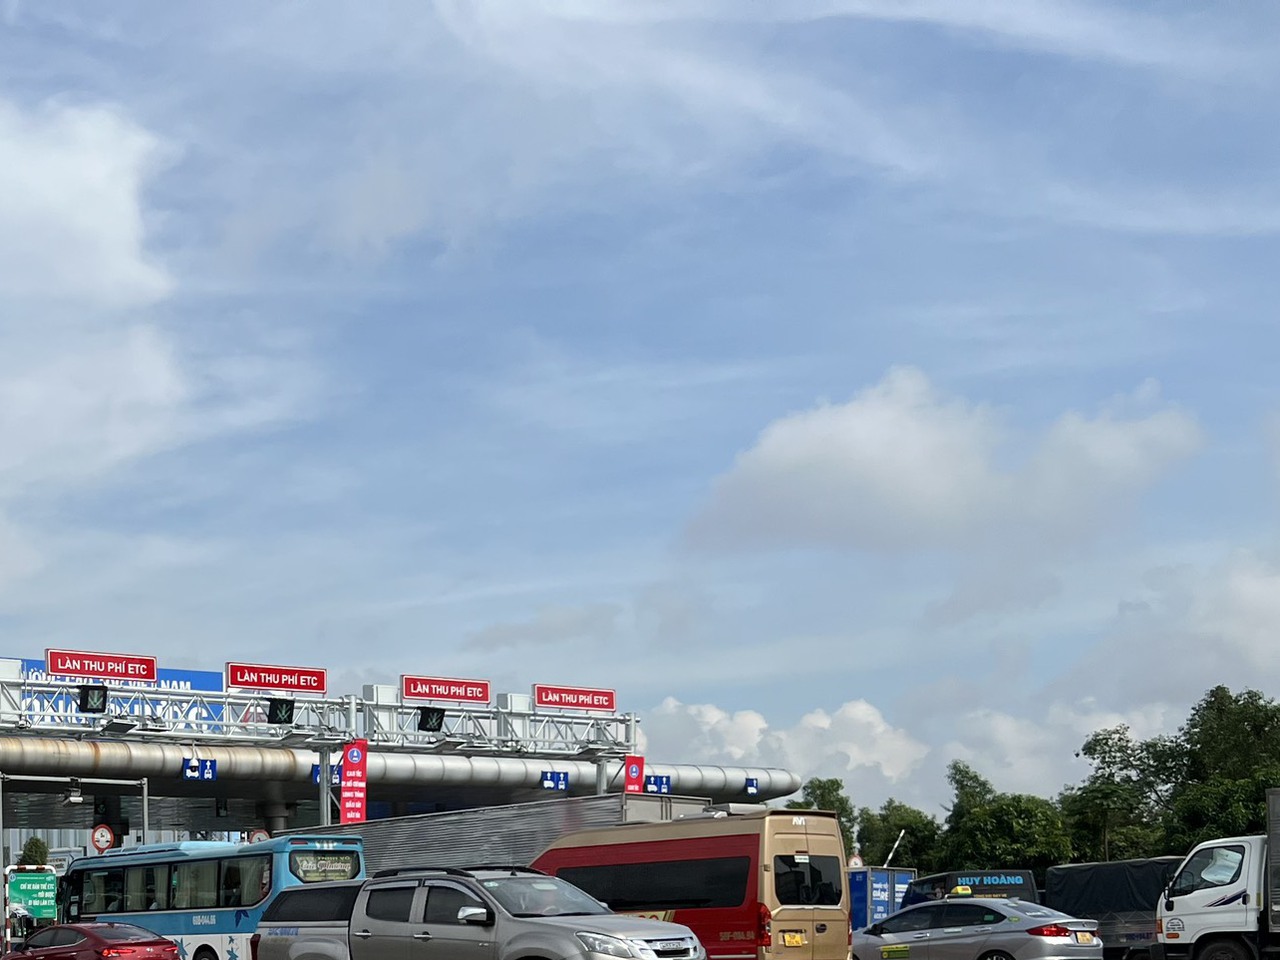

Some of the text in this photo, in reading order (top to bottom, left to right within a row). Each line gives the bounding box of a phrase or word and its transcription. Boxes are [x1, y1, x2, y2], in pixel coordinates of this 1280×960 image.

[57, 656, 147, 675] LÀN THU PHÍ ETC
[237, 669, 318, 687] LÀN THU PHÍ ETC
[410, 680, 483, 698] LÀN THU PHÍ ETC
[542, 690, 609, 706] LÀN THU PHÍ ETC
[957, 874, 1024, 886] HUY HOÀNG
